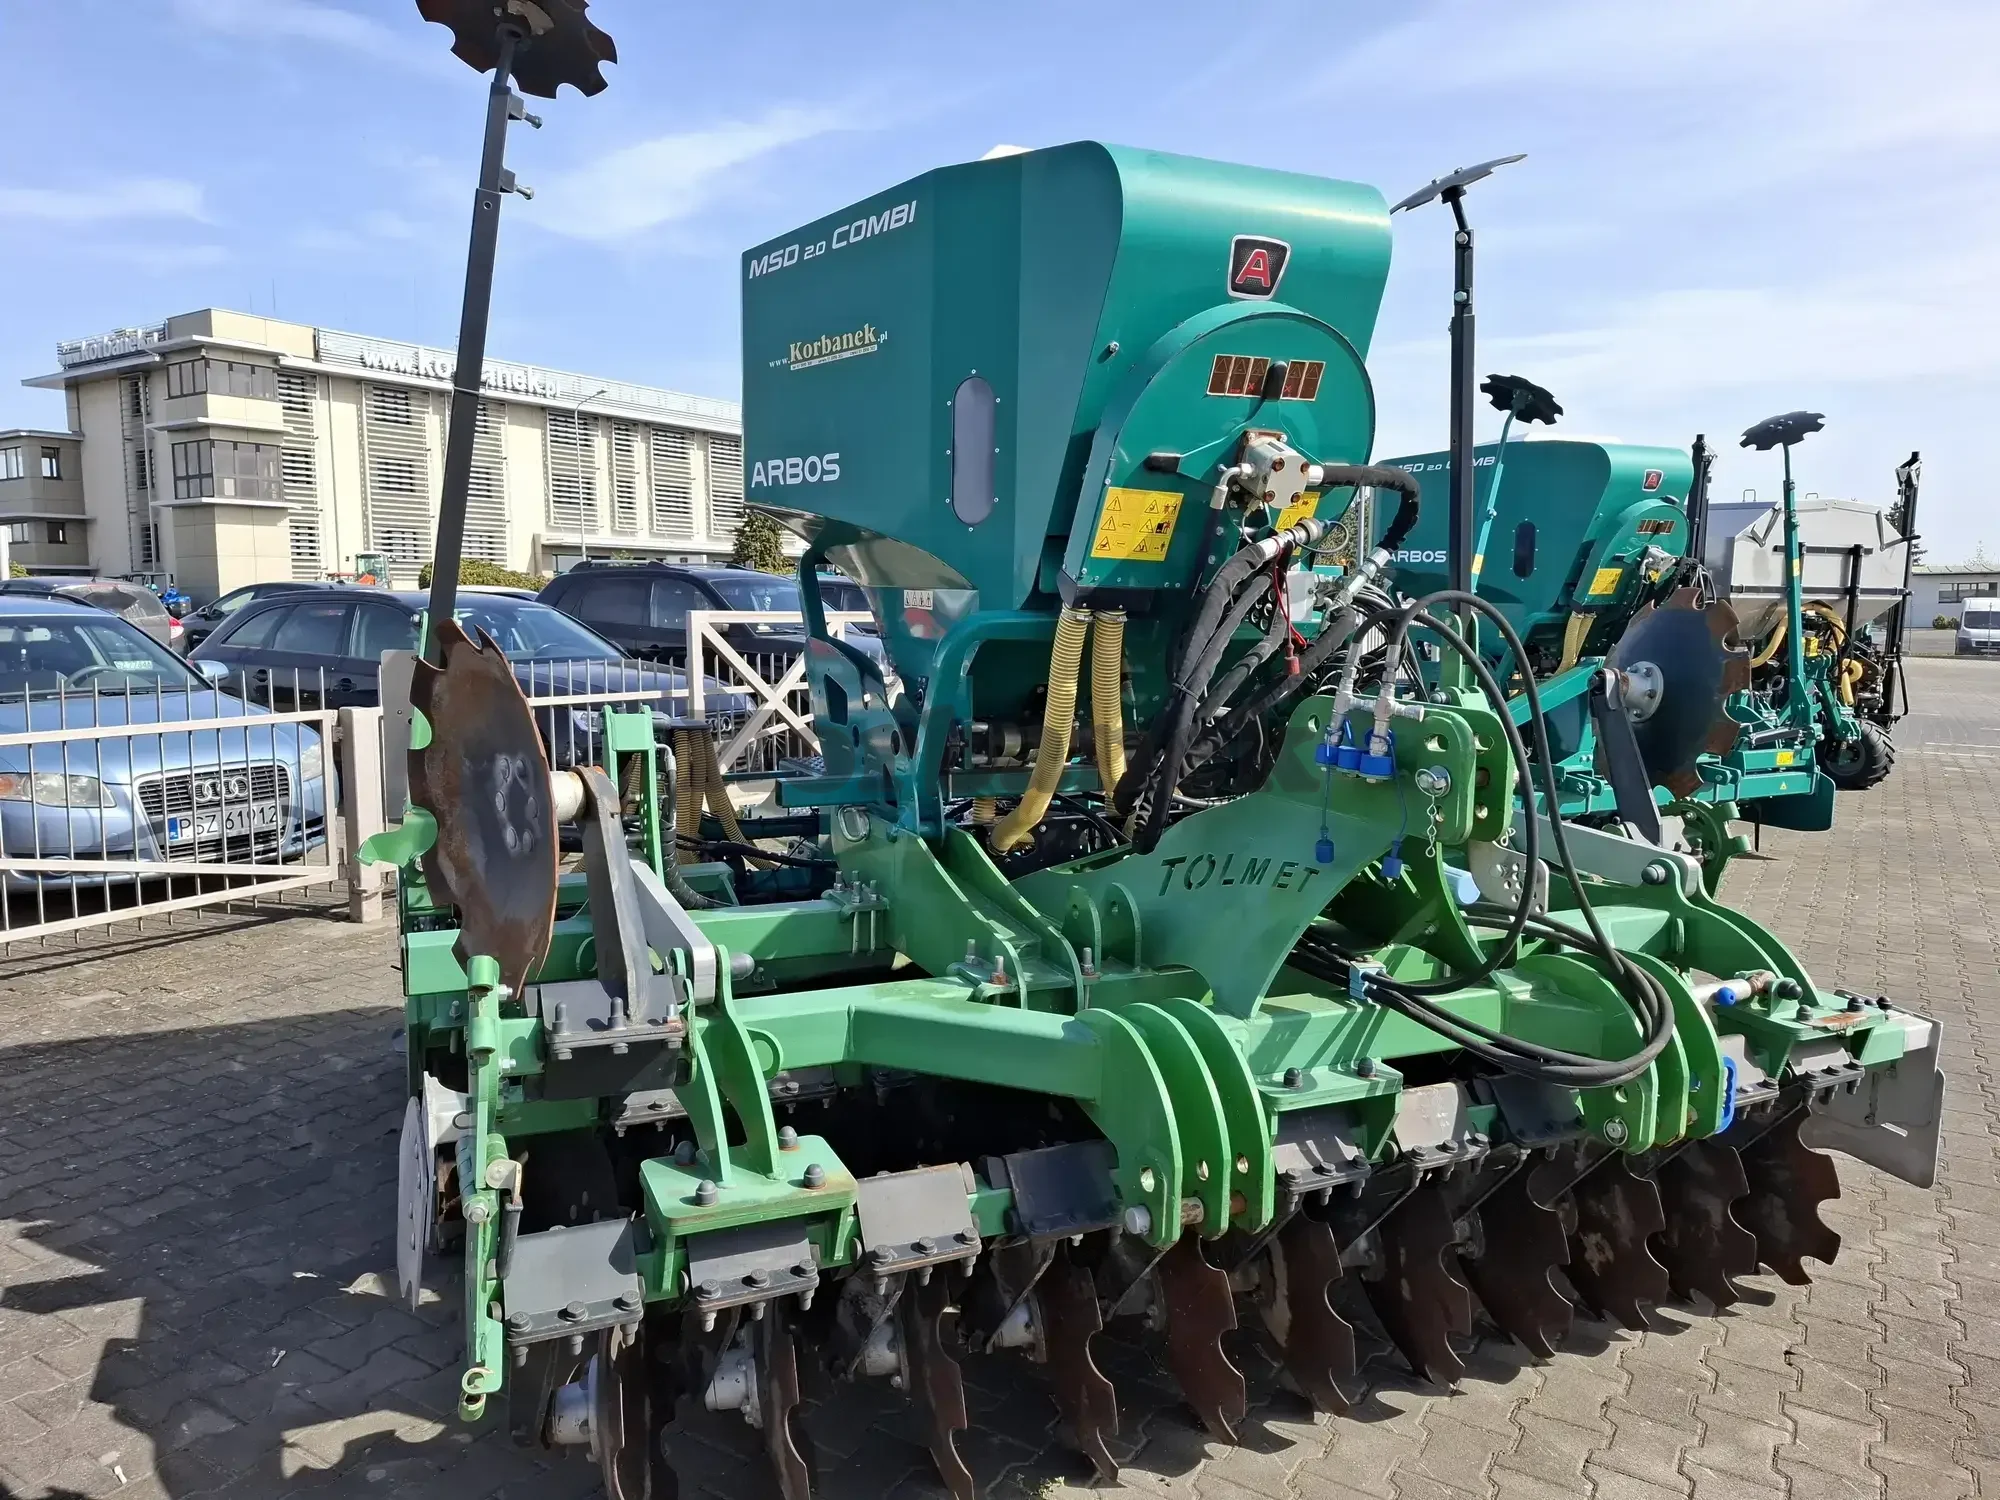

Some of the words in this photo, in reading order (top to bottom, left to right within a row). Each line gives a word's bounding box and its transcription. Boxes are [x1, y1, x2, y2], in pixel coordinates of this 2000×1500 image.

[748, 244, 800, 279] MSD
[803, 239, 827, 261] 2.0
[831, 200, 918, 250] COMBI
[359, 345, 561, 400] www.koanek.pl
[750, 452, 841, 490] ARBOS
[179, 814, 218, 837] PSZ
[1158, 851, 1321, 897] TOLMET
